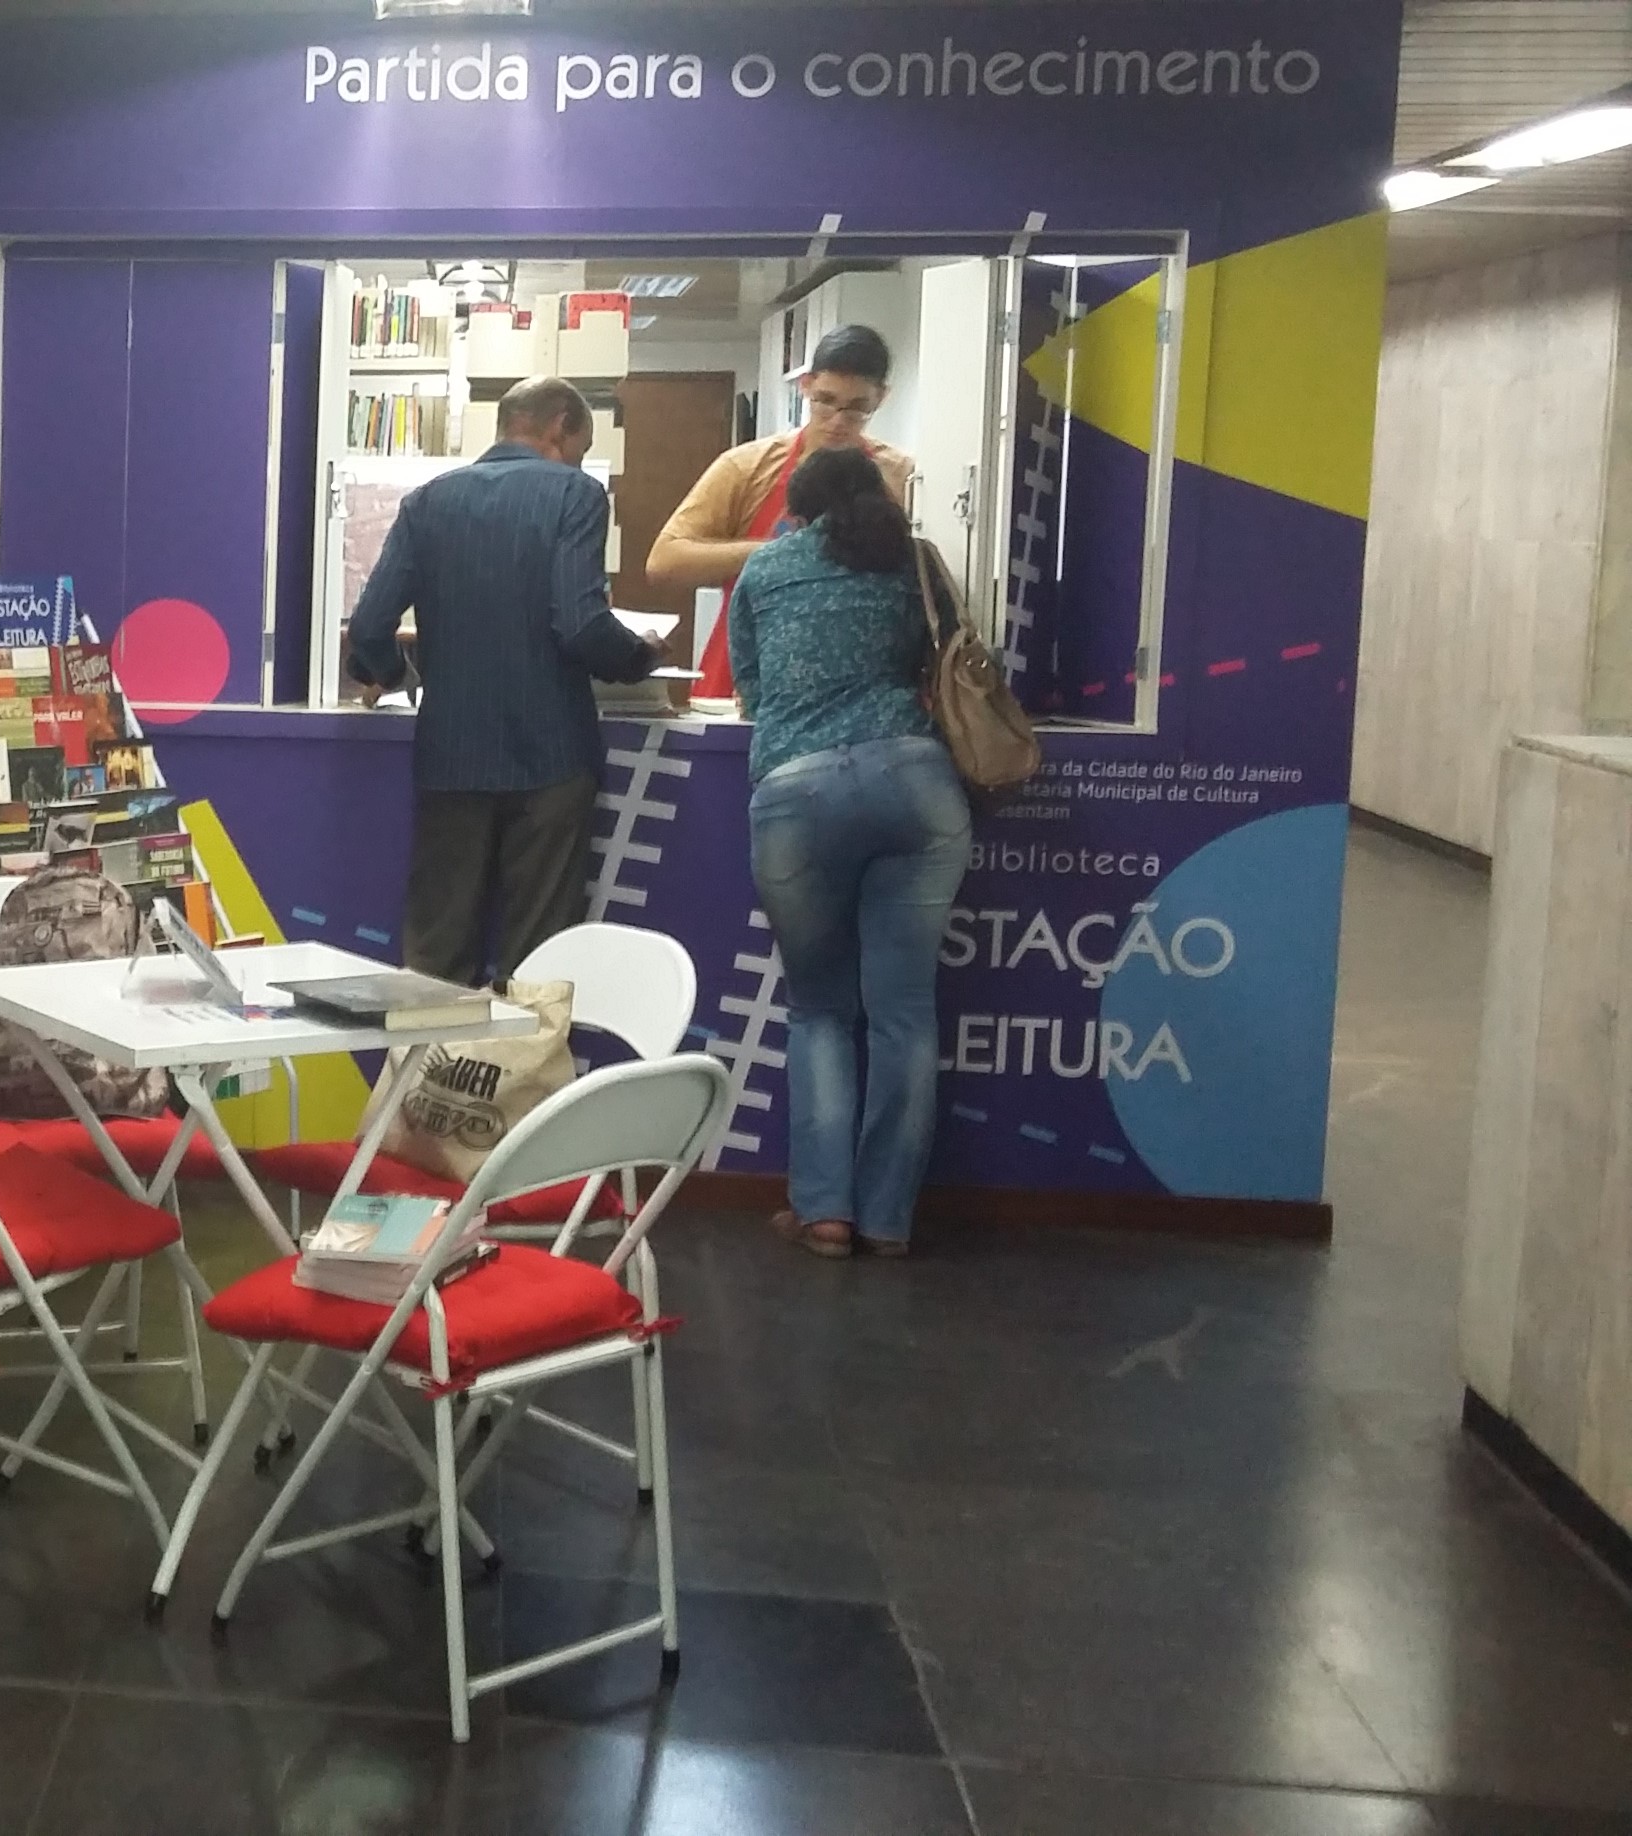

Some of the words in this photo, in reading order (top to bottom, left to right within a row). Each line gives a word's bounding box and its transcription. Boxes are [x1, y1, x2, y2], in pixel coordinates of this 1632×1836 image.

[305, 42, 528, 103] Partida
[555, 53, 703, 112] para
[731, 53, 776, 98] o
[803, 36, 1321, 97] conhecimento
[1062, 761, 1083, 778] da
[1088, 760, 1148, 780] Cidade
[1152, 762, 1175, 780] do
[1179, 763, 1208, 782] Rio
[1239, 764, 1303, 783] Janeiro
[1077, 782, 1164, 803] Municipal
[1167, 784, 1189, 801] de
[1193, 785, 1260, 804] Cultura
[938, 901, 1237, 989] STAÇÃO
